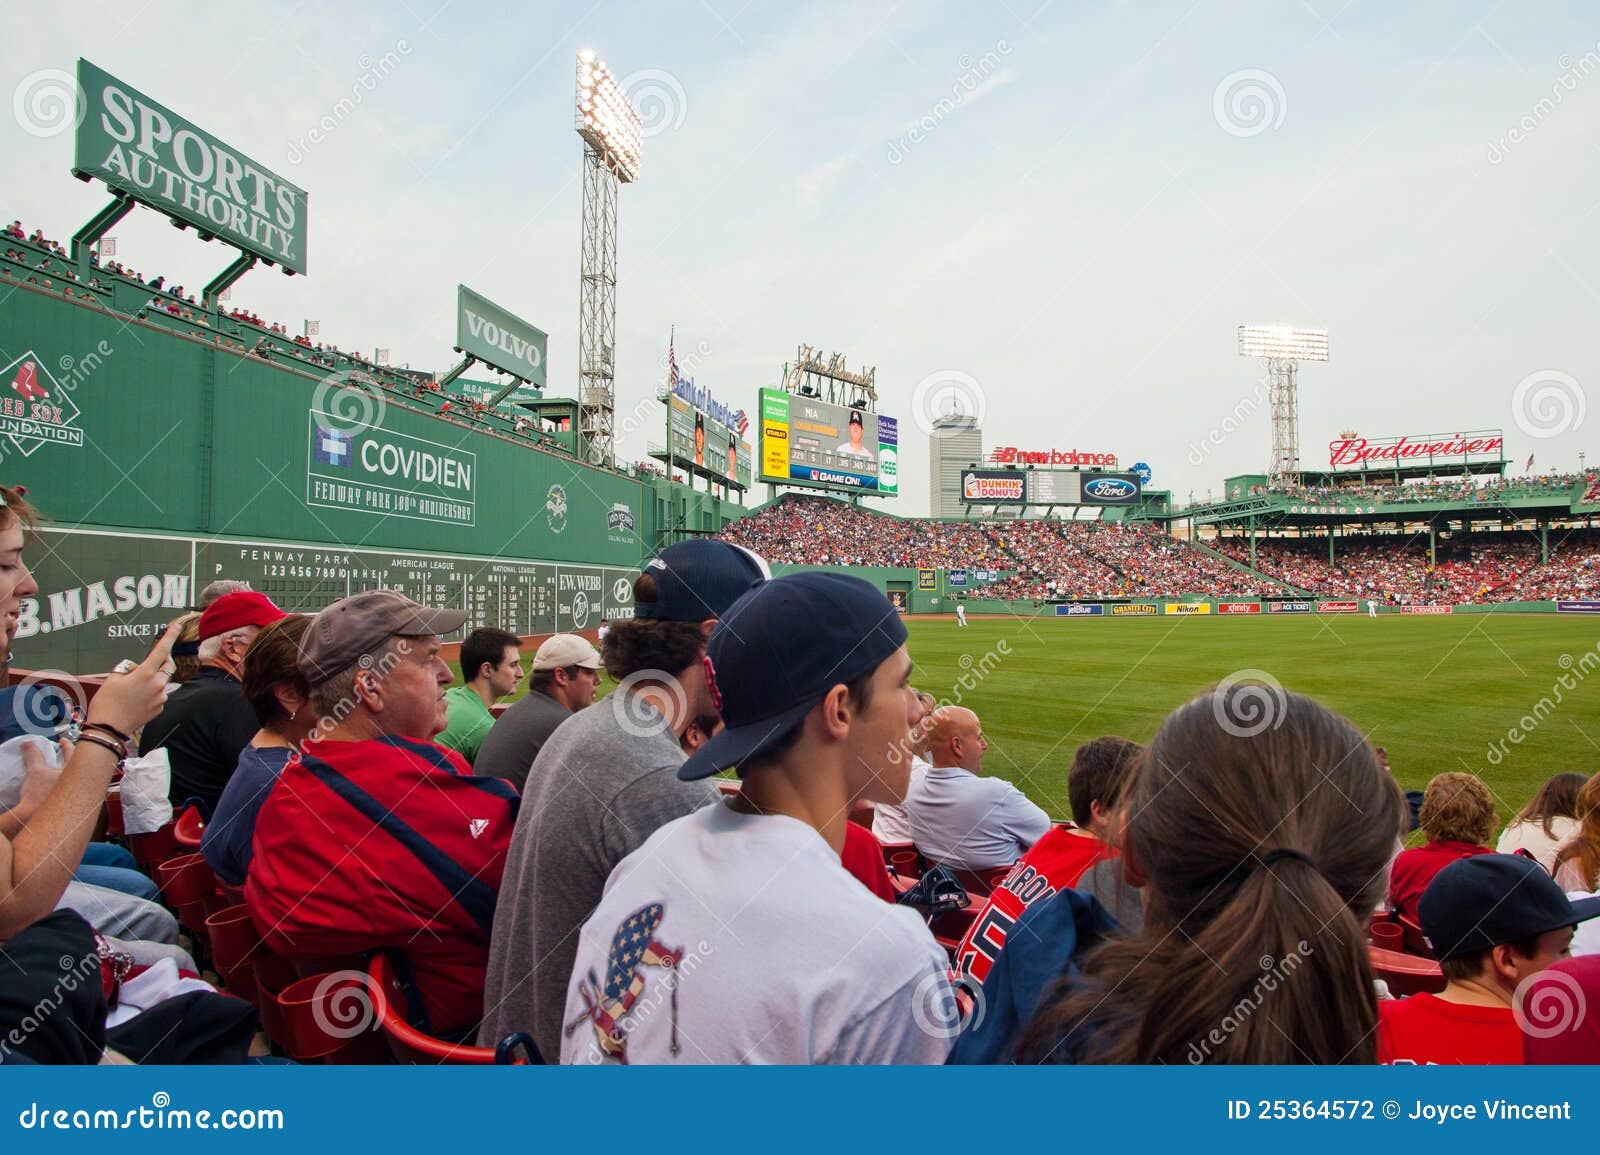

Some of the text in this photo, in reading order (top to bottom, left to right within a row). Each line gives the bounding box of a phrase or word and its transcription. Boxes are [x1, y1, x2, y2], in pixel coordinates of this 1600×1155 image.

[101, 86, 296, 230] SPORTS
[101, 143, 296, 260] AUTHORITY
[464, 309, 541, 367] VOLVO
[0, 396, 63, 424] ED SOX
[1017, 447, 1116, 466] new balance
[1329, 434, 1503, 467] Budweiser
[361, 440, 471, 491] COVIDIEN
[820, 471, 861, 486] GAME ON!
[981, 480, 1022, 489] DUNKIN'
[315, 481, 361, 505] FENWAY
[366, 494, 390, 510] PARK
[981, 488, 1021, 498] DONUTS
[1094, 481, 1127, 497] Ford
[240, 549, 350, 565] FENWAY PARK
[391, 559, 455, 570] AMERICAN LEAGUE
[215, 563, 222, 575] P
[1176, 604, 1199, 613] Nikon
[1227, 603, 1251, 614] xfinity
[107, 625, 150, 638] SINCE
